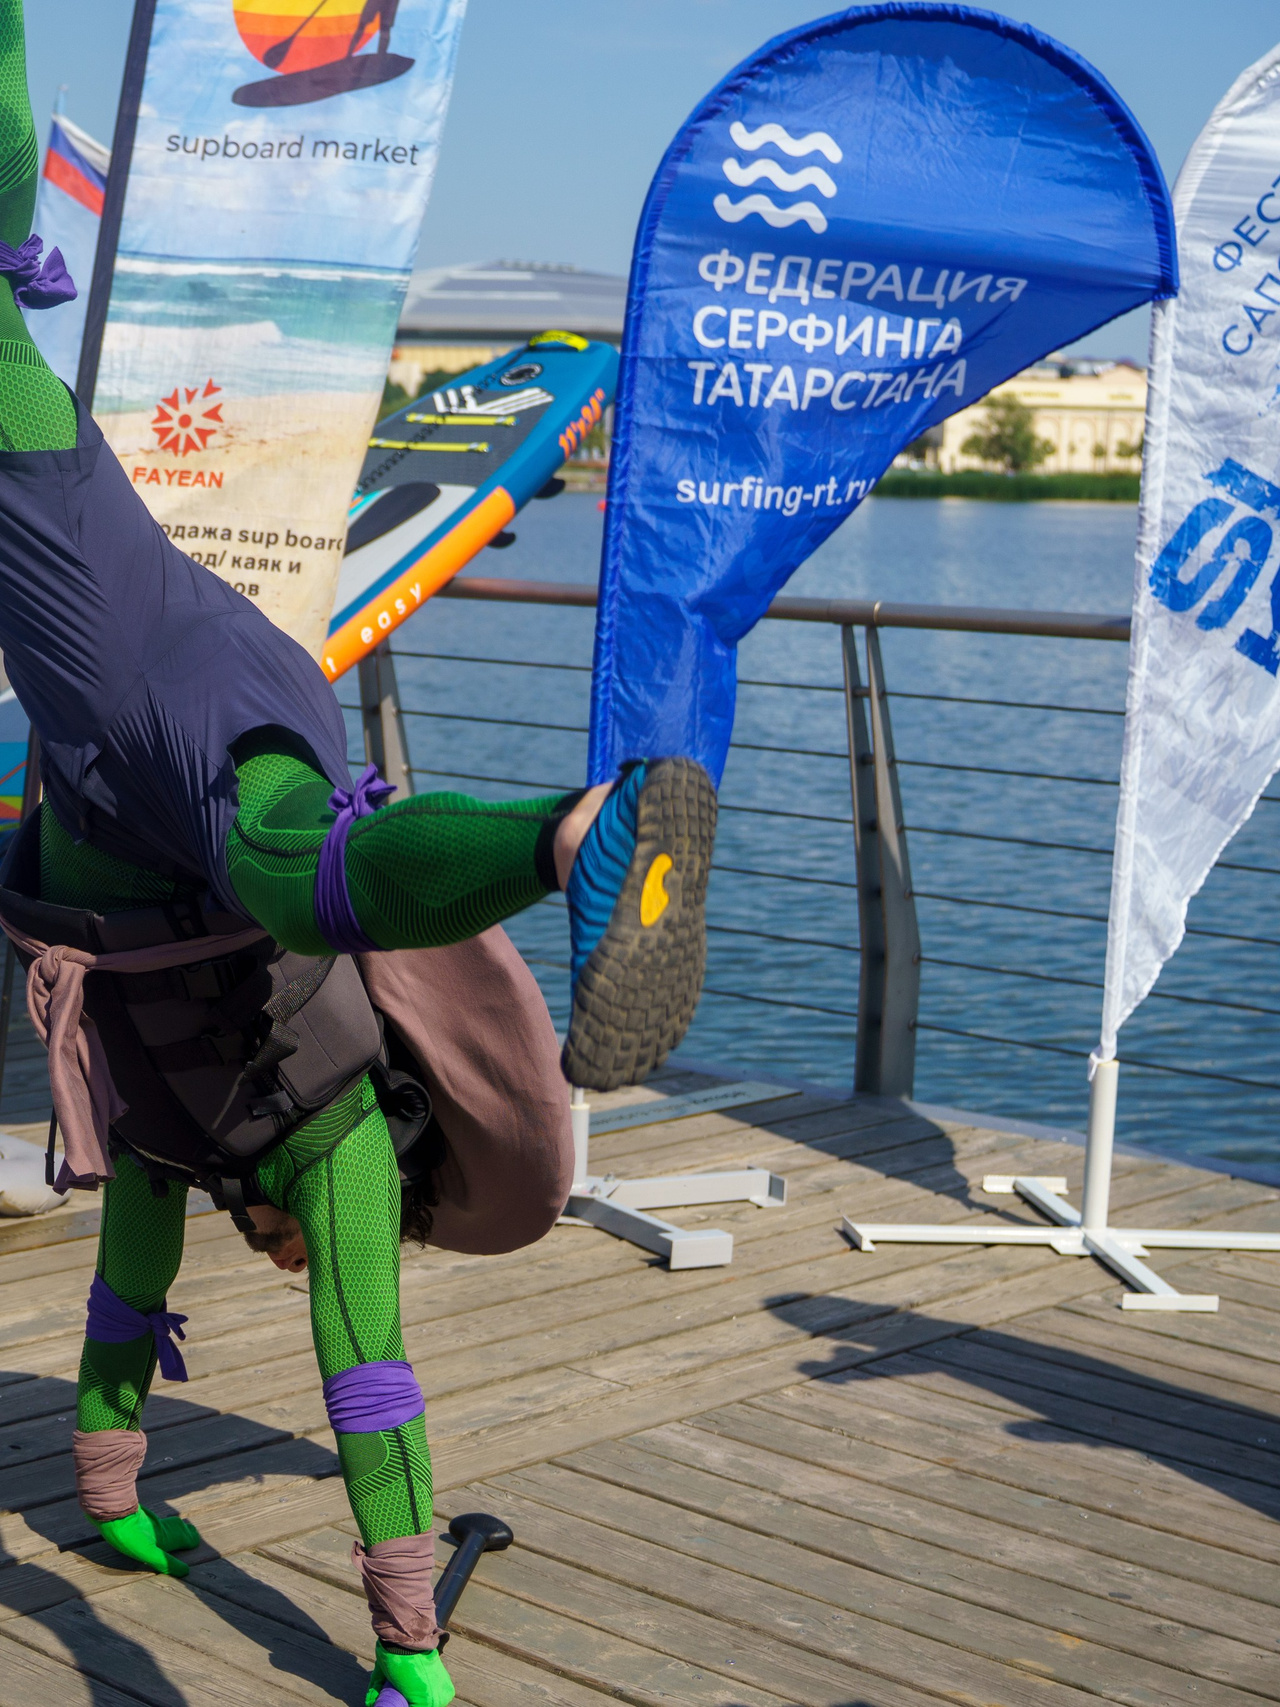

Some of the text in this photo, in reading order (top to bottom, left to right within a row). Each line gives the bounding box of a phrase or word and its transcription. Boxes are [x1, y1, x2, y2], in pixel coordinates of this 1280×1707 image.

[166, 134, 420, 166] supboard market
[1213, 175, 1280, 272] ФЕС
[697, 248, 1028, 309] ФЕДЕРАЦИЯ
[1222, 258, 1280, 356] САП
[692, 304, 963, 360] СЕРФИНГА
[687, 358, 967, 412] ТАТАРСТАНА
[132, 466, 224, 489] FAYEAN
[676, 475, 877, 517] surfing-rt.ru
[161, 523, 232, 541] одажа
[238, 528, 279, 548] sup
[191, 549, 302, 574] рд/ каяк и
[226, 582, 260, 597] ов
[360, 582, 421, 644] easy
